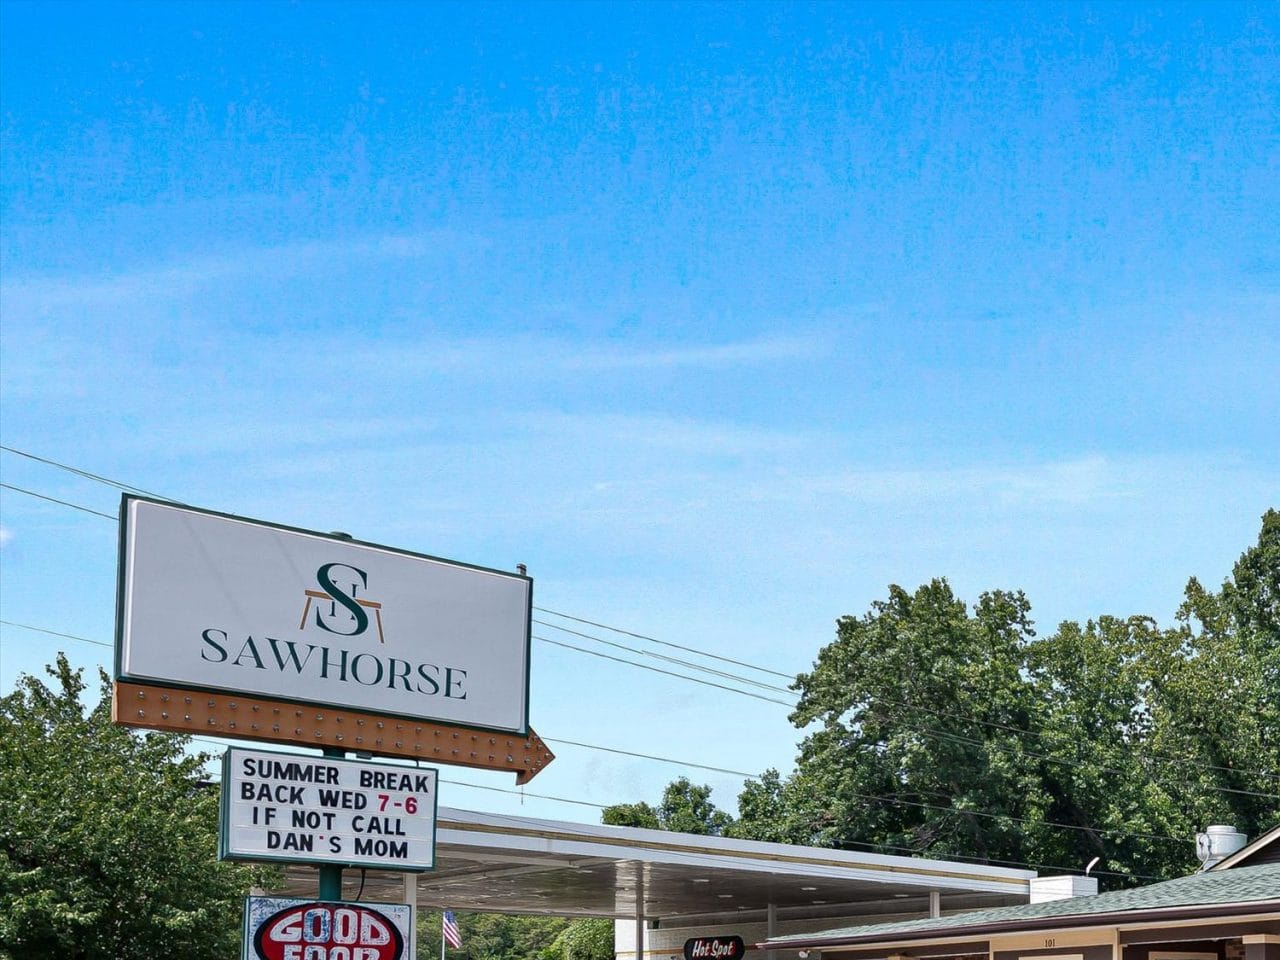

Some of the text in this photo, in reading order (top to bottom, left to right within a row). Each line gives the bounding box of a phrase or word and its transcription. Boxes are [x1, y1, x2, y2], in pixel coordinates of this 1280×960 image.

[200, 627, 468, 700] SAWHORSE
[243, 758, 429, 793] SUMMER BREAK
[240, 782, 418, 814] BACK WED 7-6
[252, 806, 406, 836] IF NOT CALL
[354, 837, 408, 859] MOM
[269, 908, 390, 946] GOOD
[692, 940, 734, 958] Hot Spot
[1044, 938, 1055, 948] 101
